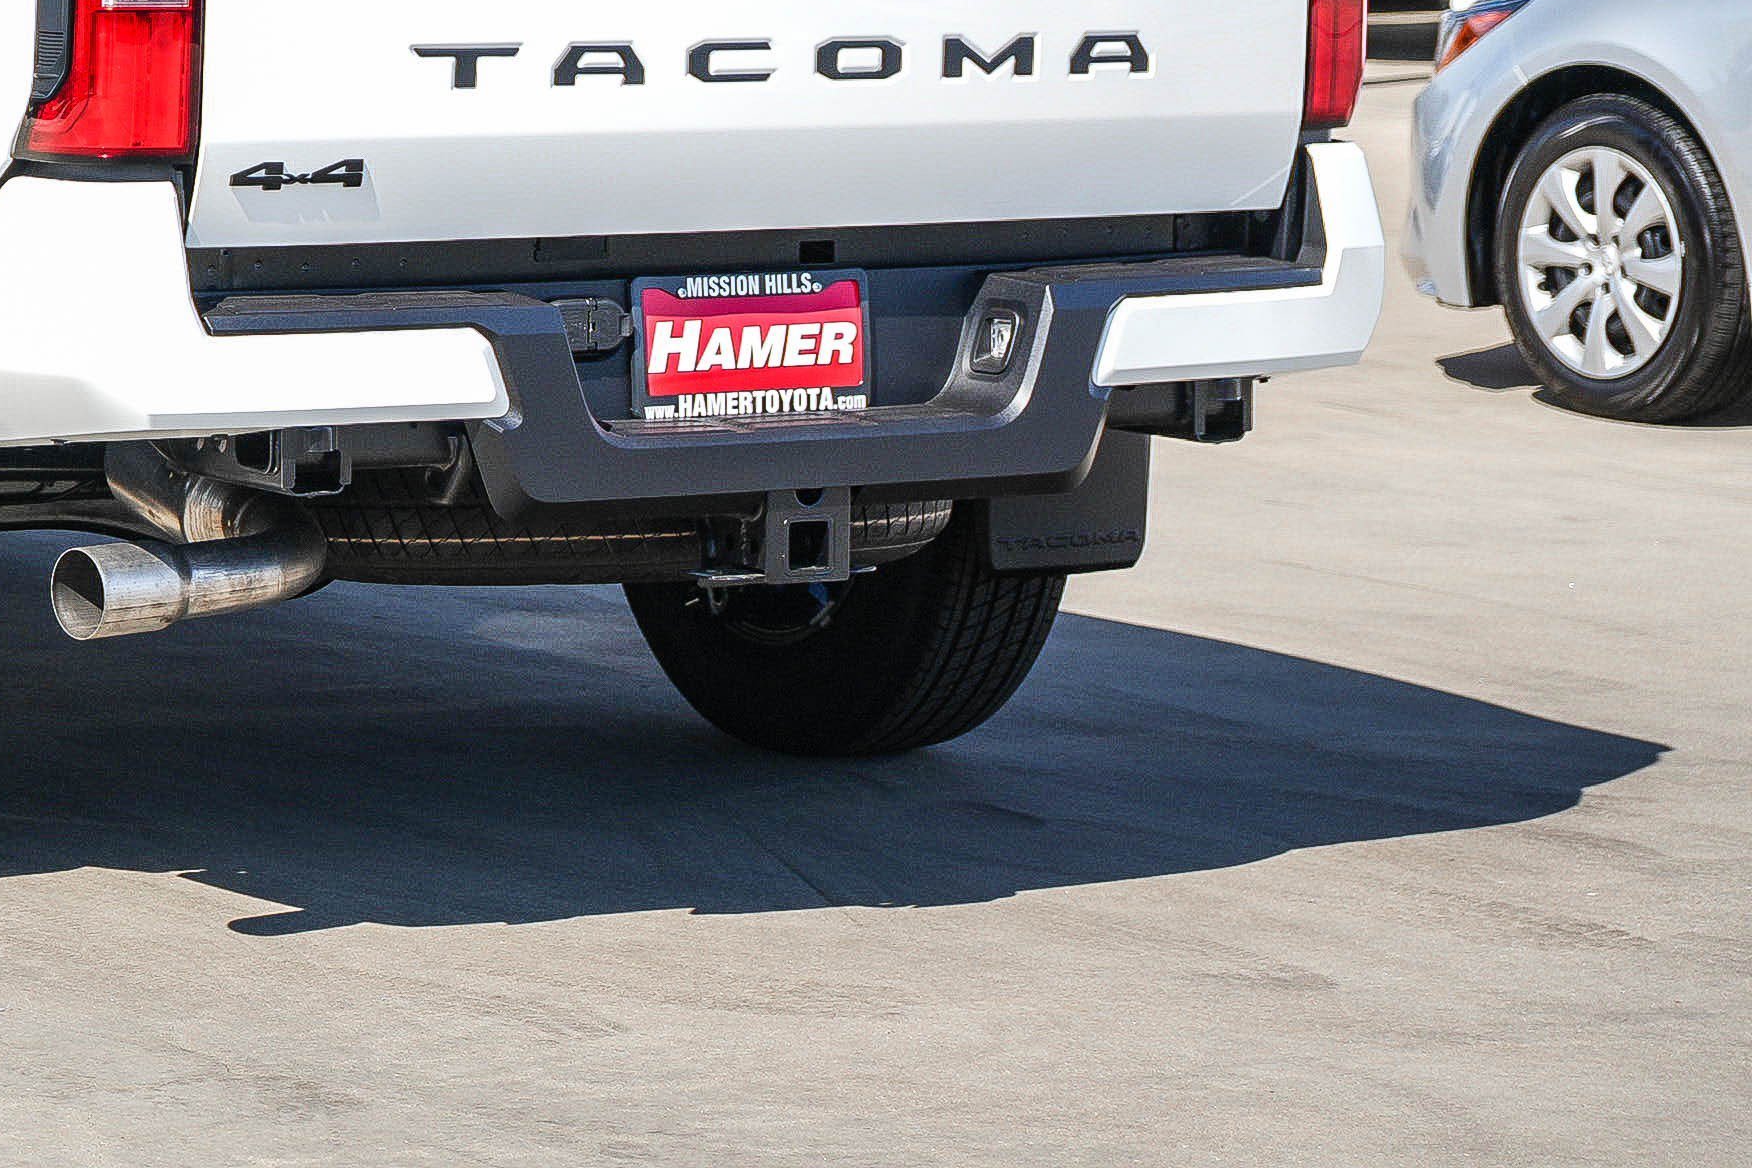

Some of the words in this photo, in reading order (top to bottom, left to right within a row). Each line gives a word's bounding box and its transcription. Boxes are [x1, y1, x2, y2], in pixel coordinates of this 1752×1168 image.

[411, 30, 1151, 89] TACOMA
[686, 275, 760, 298] MISSION
[648, 319, 858, 374] HAMER
[644, 386, 867, 420] www.HAMERTOYOTA.com
